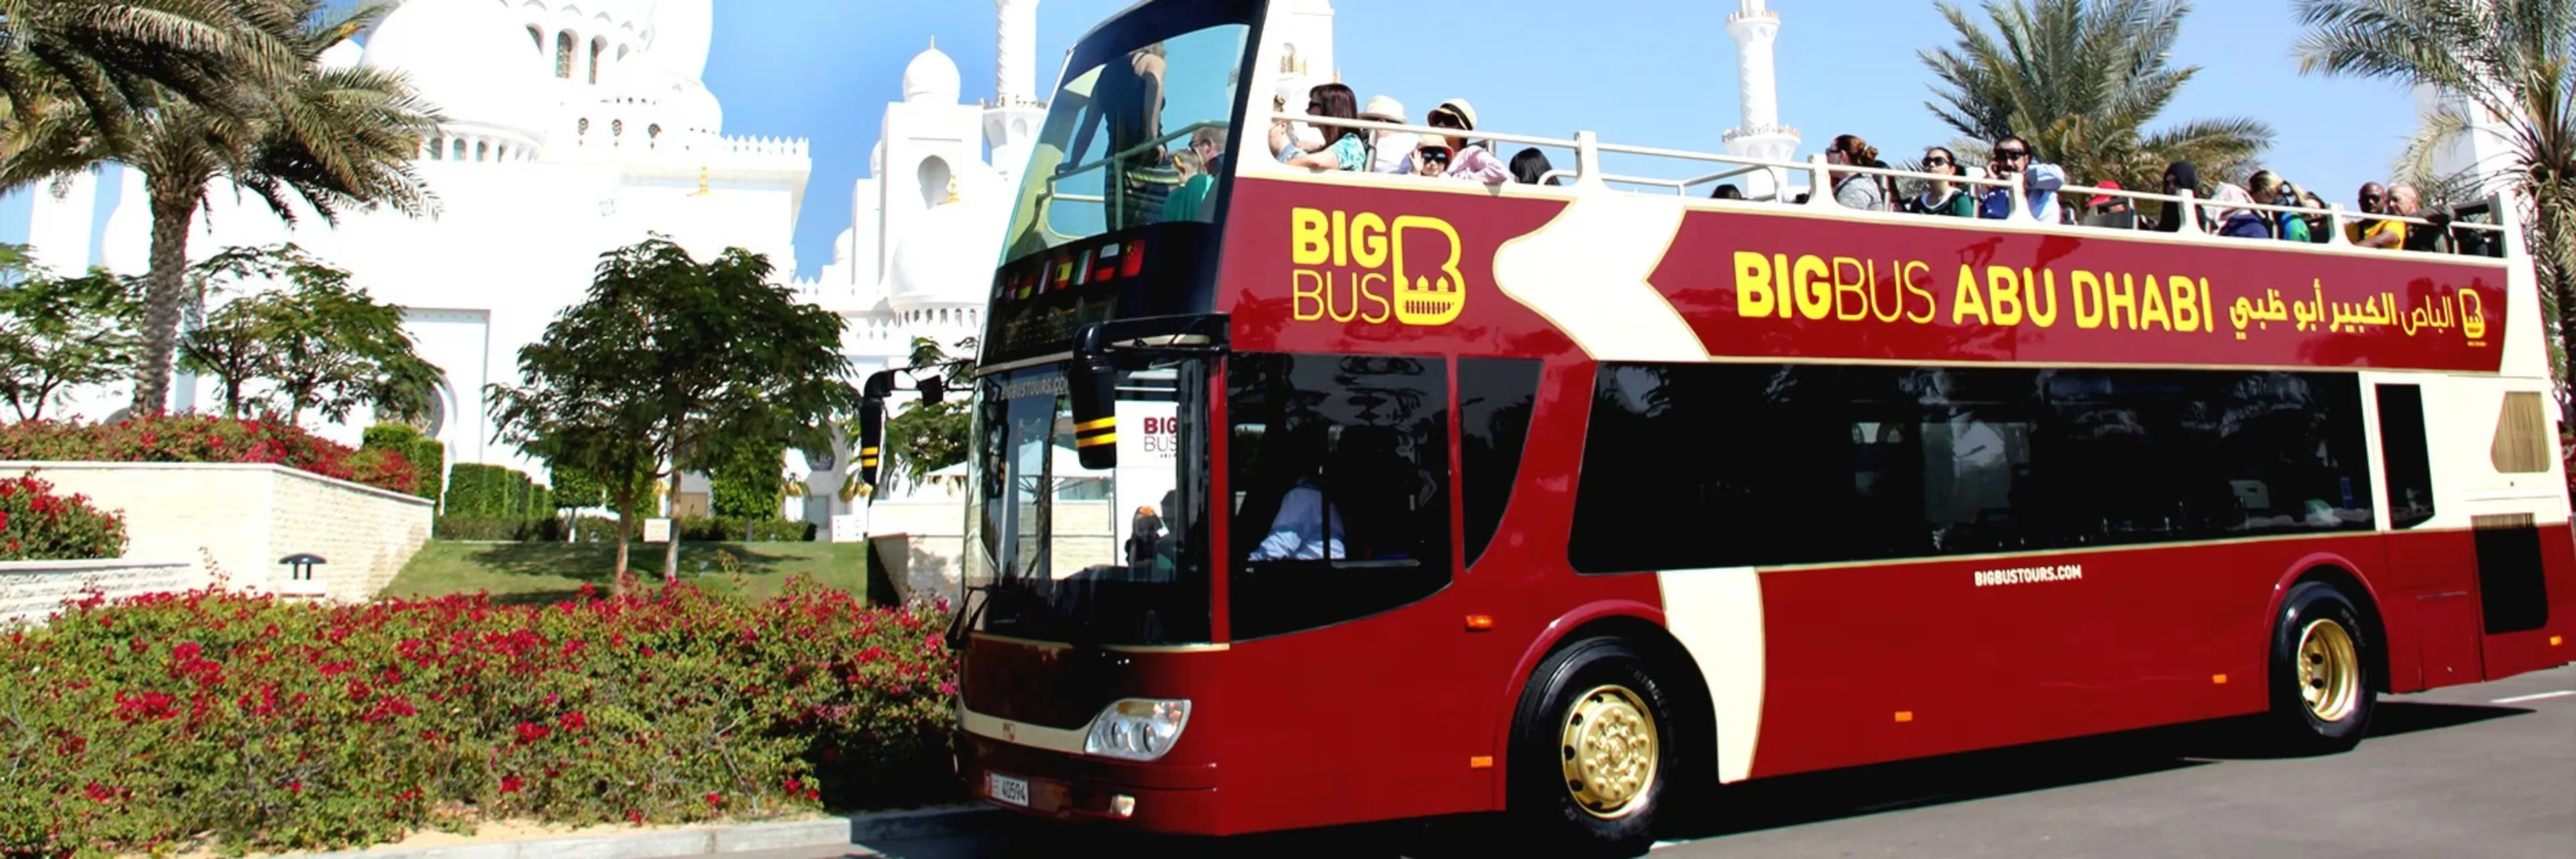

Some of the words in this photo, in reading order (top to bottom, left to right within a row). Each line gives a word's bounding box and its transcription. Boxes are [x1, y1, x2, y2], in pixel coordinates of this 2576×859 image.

[1291, 207, 1389, 268] BIG
[1293, 268, 1391, 324] BUS
[1951, 264, 2058, 328] ABU
[2071, 270, 2214, 333] DHABI
[2229, 288, 2288, 340] ظبي
[2293, 277, 2326, 332] أبو
[2329, 292, 2398, 333] الكبير
[2400, 295, 2455, 336] الباص
[1144, 417, 1179, 435] BIG
[1144, 436, 1177, 452] BUS
[1974, 564, 2082, 587] BIGBUSTOURS.COM
